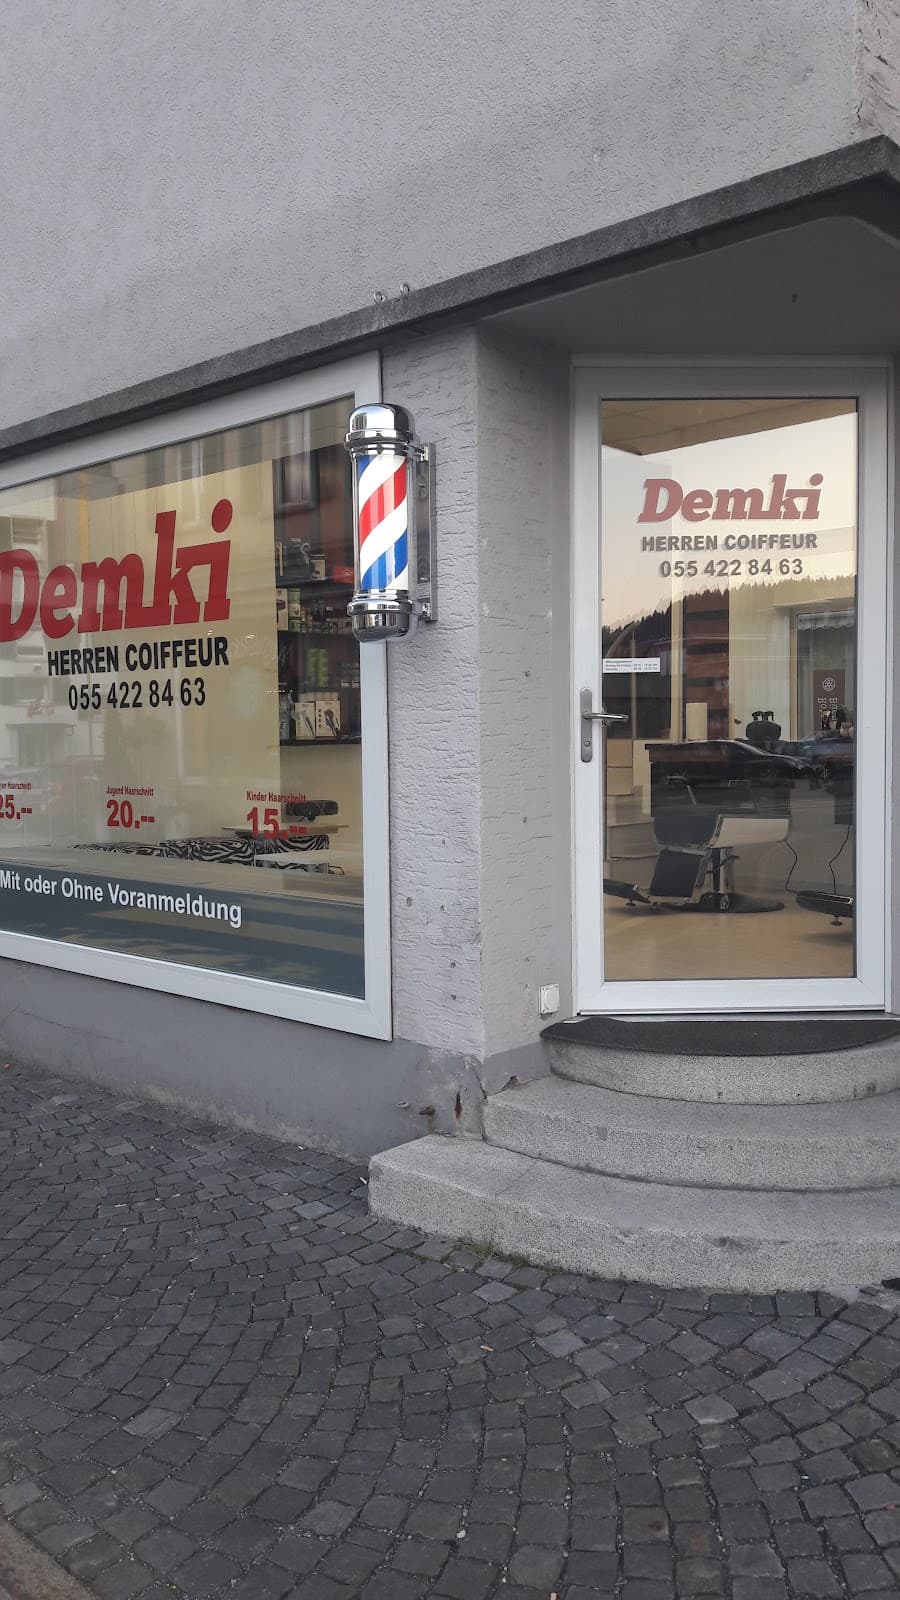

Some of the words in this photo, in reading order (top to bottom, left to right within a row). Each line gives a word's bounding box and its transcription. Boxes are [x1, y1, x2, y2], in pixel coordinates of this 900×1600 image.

[637, 473, 824, 523] Demki
[642, 534, 718, 551] HERREN
[723, 533, 818, 550] COIFFEUR
[0, 498, 233, 642] Demki
[660, 560, 698, 577] 055
[703, 559, 742, 577] 422
[748, 558, 773, 575] 84
[779, 558, 803, 575] 63
[48, 645, 119, 676] HERREN
[125, 636, 229, 671] COIFFEUR
[68, 684, 101, 711] 055
[107, 680, 142, 708] 422
[149, 678, 173, 708] 84
[180, 677, 206, 706] 63
[106, 785, 124, 795] Jugend
[125, 785, 154, 797] Haarschnitt
[246, 790, 267, 802] Kinder
[268, 791, 306, 803] Haarschnitt
[0, 870, 20, 890] Mit
[24, 874, 57, 896] oder
[61, 877, 103, 902] Ohne
[107, 882, 242, 928] Voranmeldung
